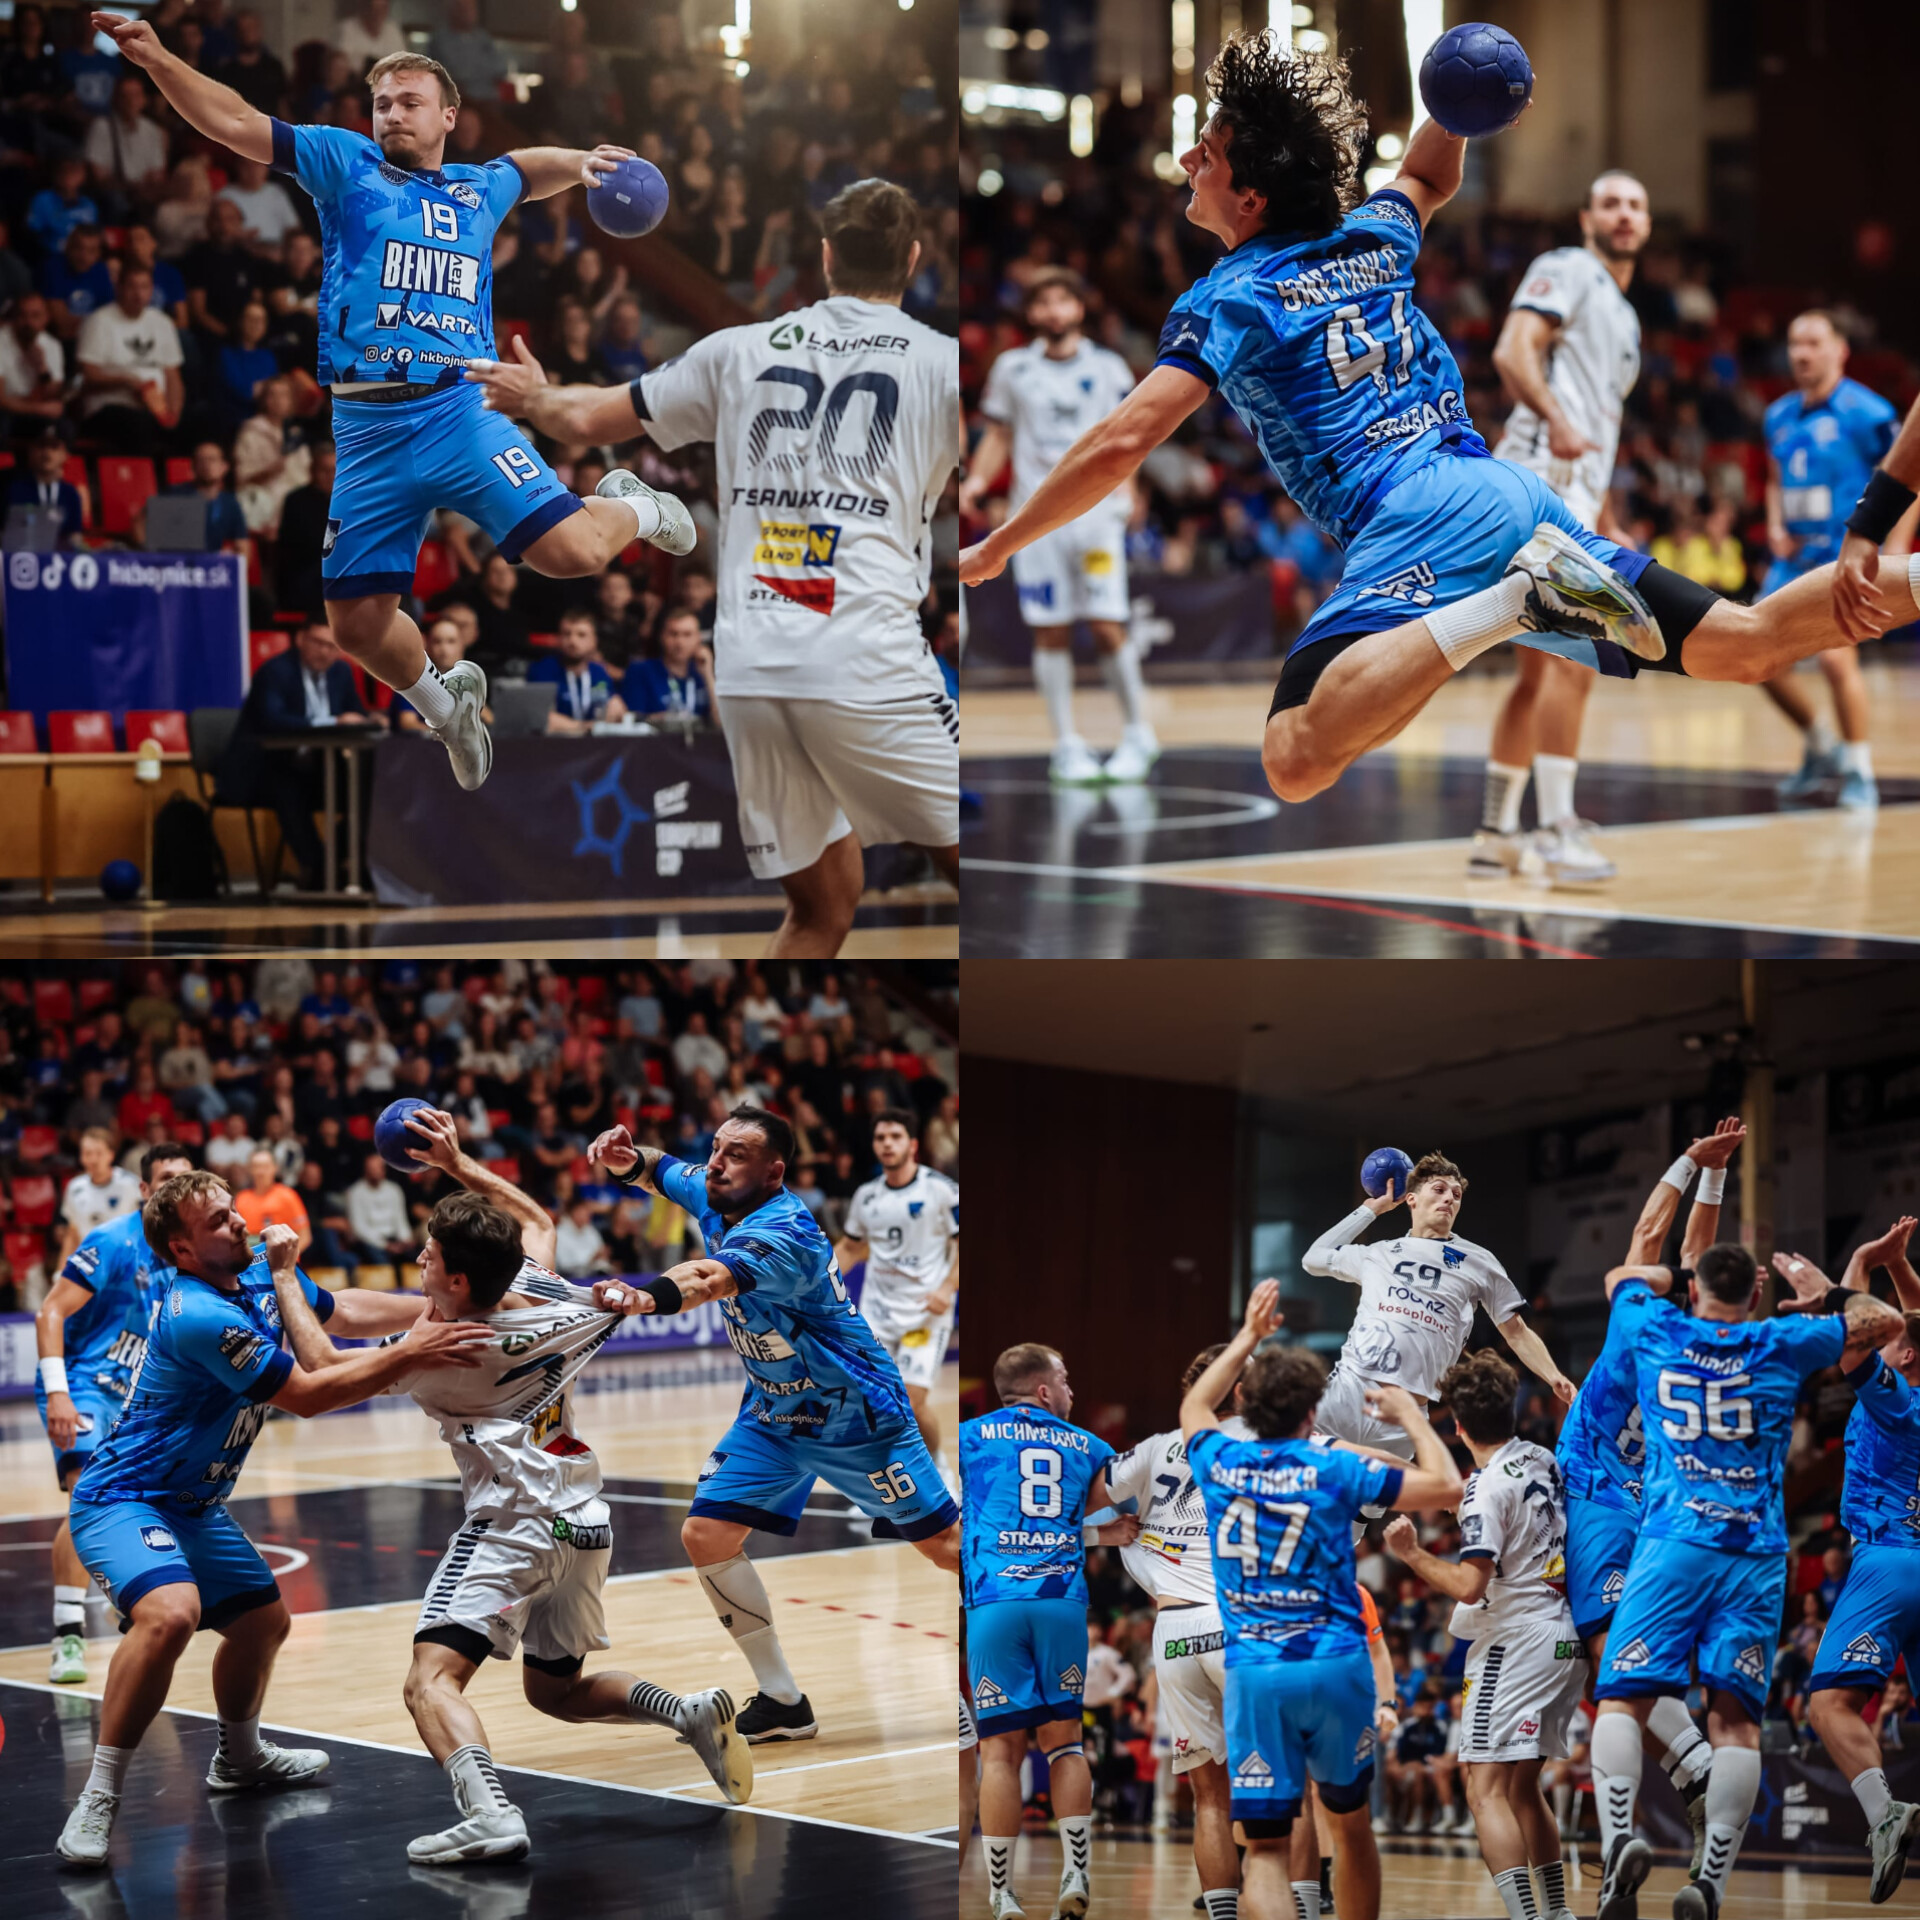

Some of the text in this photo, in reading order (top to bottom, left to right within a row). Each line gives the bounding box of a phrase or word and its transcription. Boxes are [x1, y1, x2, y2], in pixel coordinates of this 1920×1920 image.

[419, 197, 459, 242] 19
[381, 239, 449, 296] BENY
[406, 309, 477, 335] VARTA
[808, 332, 911, 352] LAHNER
[748, 365, 899, 480] 20
[490, 445, 542, 490] 19
[1394, 1260, 1442, 1291] 59
[1657, 1368, 1754, 1442] 56
[867, 1461, 917, 1505] 56
[1018, 1447, 1063, 1519] 8
[1216, 1495, 1312, 1578] 47
